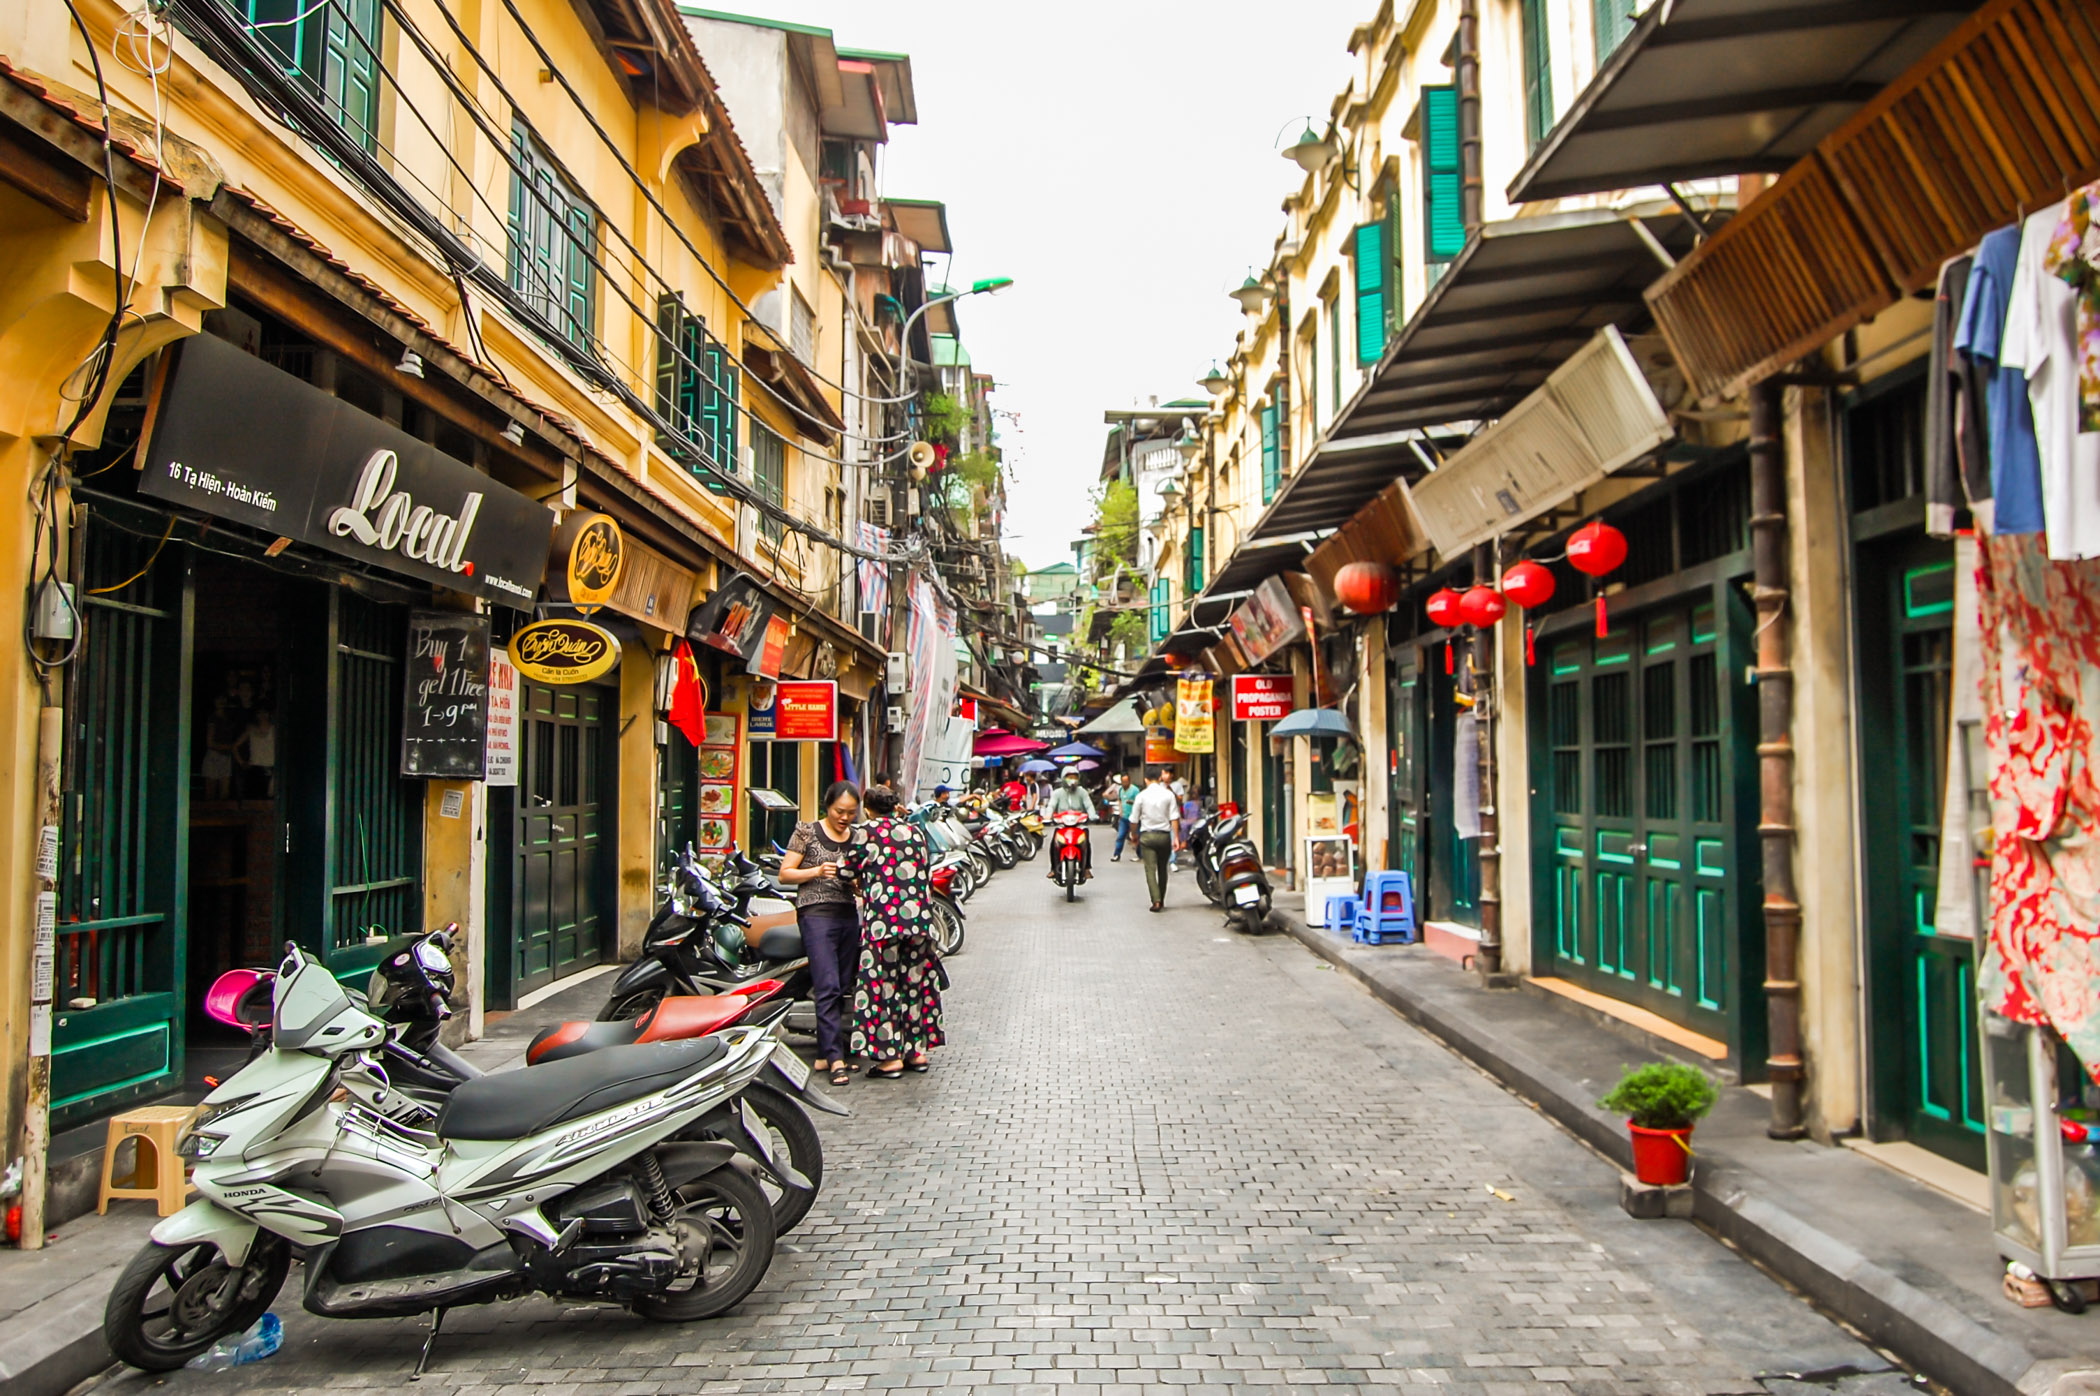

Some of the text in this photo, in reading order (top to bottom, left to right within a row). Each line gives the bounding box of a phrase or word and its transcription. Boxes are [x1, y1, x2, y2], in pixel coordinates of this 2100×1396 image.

[168, 461, 182, 479] 16
[184, 466, 198, 489] Tạ
[197, 471, 221, 495] Hiện
[226, 481, 252, 504] Hoàn
[252, 490, 277, 511] Kiếm
[414, 627, 468, 673] Buy 1
[459, 668, 485, 697] Free
[1255, 679, 1273, 690] OLD
[1237, 692, 1292, 703] PROPAGANDA
[1248, 705, 1281, 716] POSTER
[223, 1187, 267, 1198] HONDA
